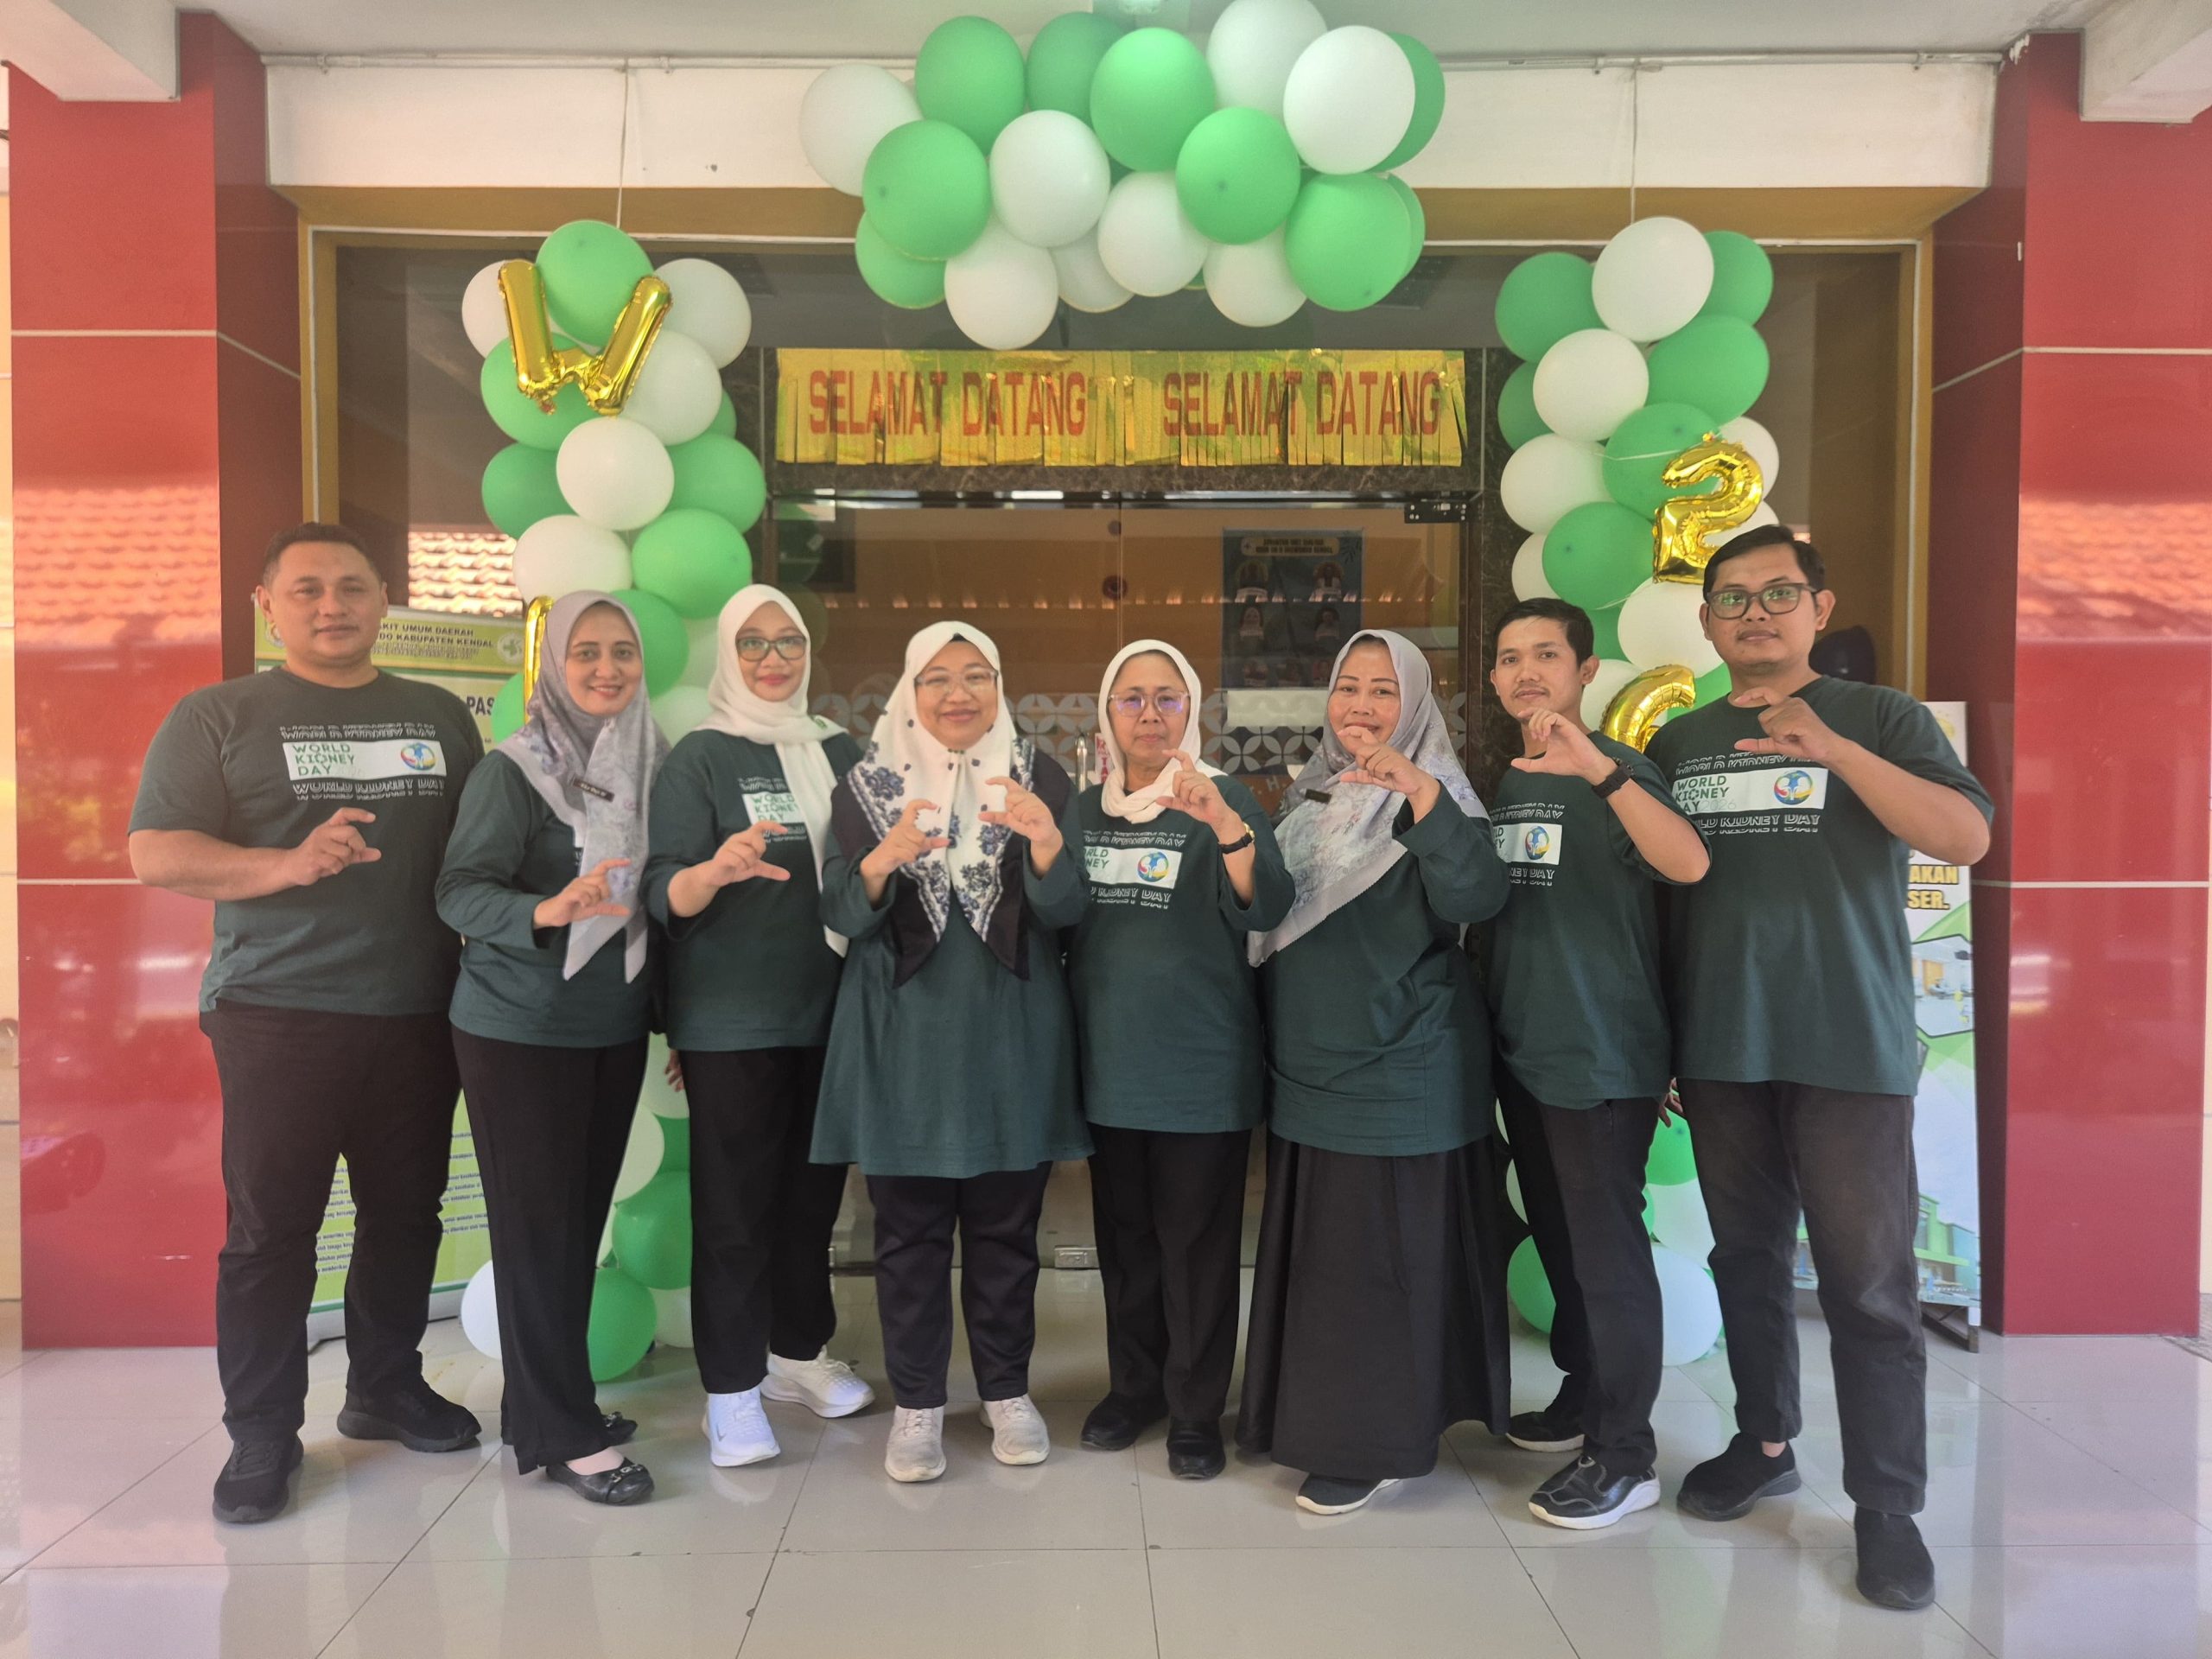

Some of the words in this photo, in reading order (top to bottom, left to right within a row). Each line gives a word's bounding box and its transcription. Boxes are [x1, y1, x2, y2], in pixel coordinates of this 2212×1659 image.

[809, 370, 948, 436] SELAMAT
[963, 372, 1087, 436] DATANG
[1163, 371, 1303, 436] SELAMAT
[1315, 371, 1440, 436] DATANG
[402, 624, 433, 633] UMUM
[396, 634, 454, 645] KABUPATEN
[456, 639, 493, 648] KENDAL
[292, 742, 351, 754] WORLD
[298, 765, 332, 777] DAY
[1677, 775, 1727, 790] WORLD
[1683, 800, 1700, 814] AY
[1783, 814, 1821, 826] DAY
